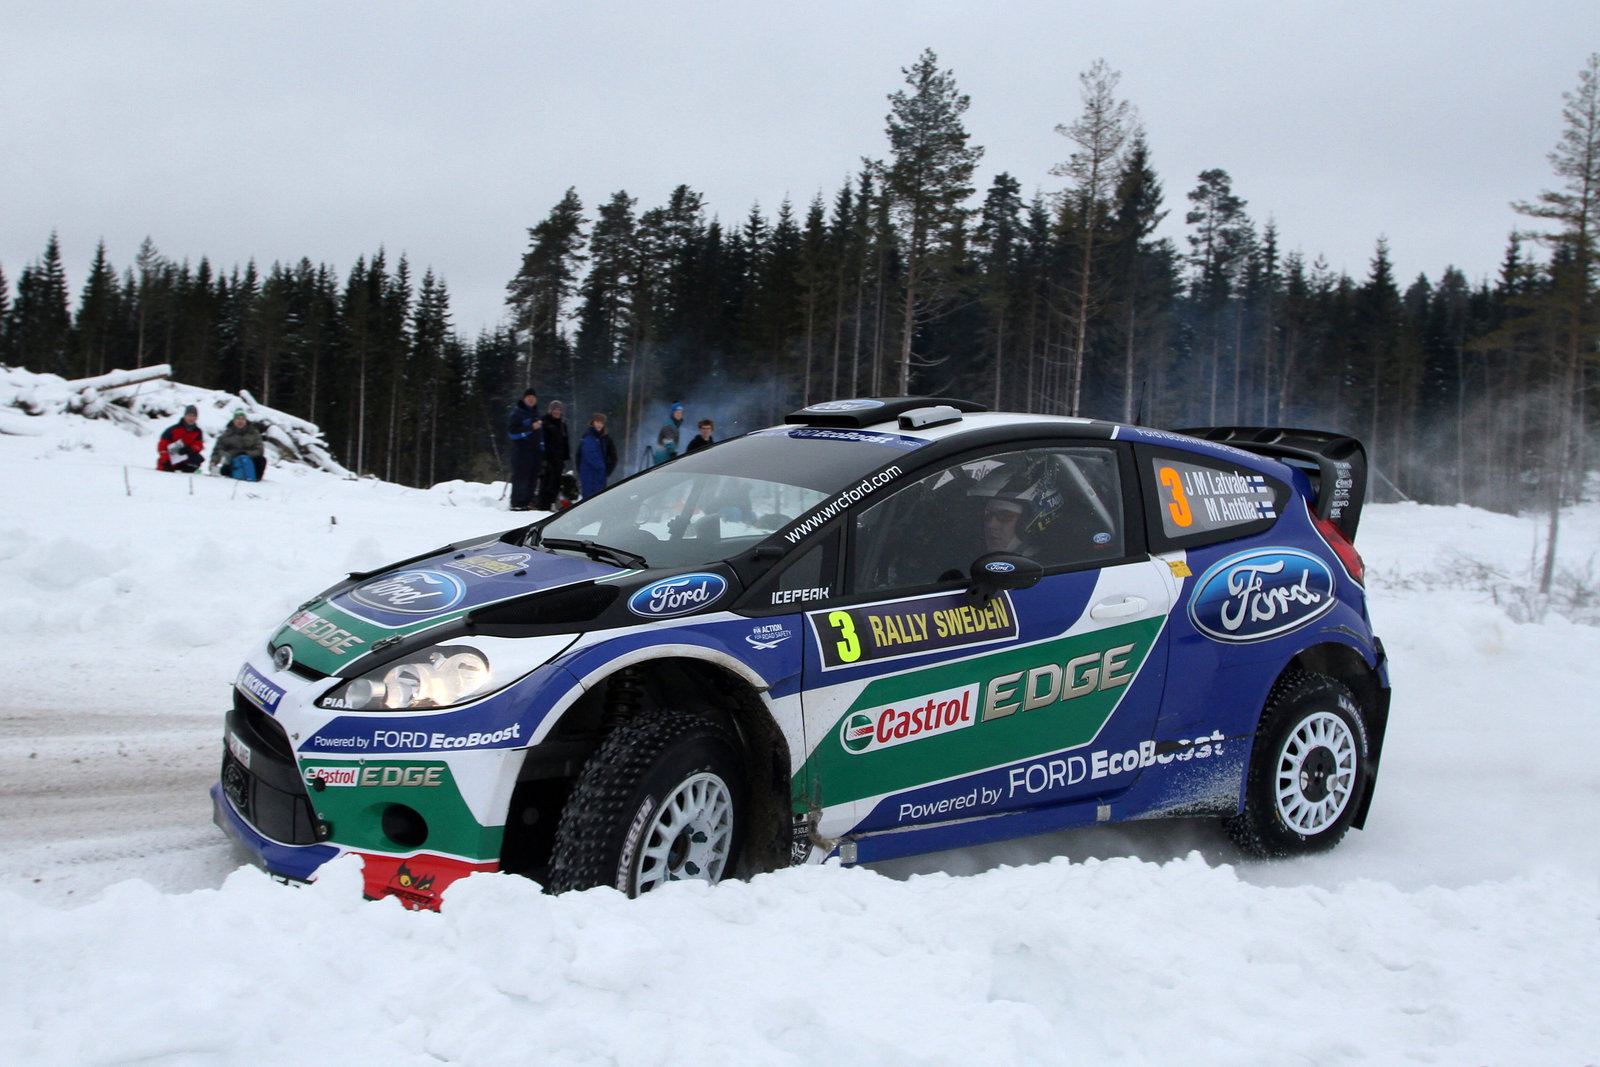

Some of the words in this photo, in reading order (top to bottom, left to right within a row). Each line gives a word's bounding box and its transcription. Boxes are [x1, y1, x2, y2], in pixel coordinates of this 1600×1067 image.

[784, 464, 903, 544] www.wrcford.com
[1159, 467, 1192, 528] 3
[1185, 473, 1194, 496] J
[1194, 472, 1209, 496] M
[1210, 470, 1249, 495] Latvala
[1203, 498, 1220, 522] M
[1222, 498, 1257, 521] Anttila
[988, 562, 1013, 572] Ford
[649, 580, 710, 612] Ford
[771, 587, 830, 605] ICEPEAK
[1220, 560, 1320, 631] Ford
[299, 618, 366, 655] EDGE
[762, 624, 783, 633] ACTION
[775, 630, 792, 638] SAFETY
[828, 610, 861, 663] 3
[868, 613, 929, 648] RALLY
[933, 596, 1010, 638] SWEDEN
[241, 671, 280, 706] MICHELIN
[875, 690, 970, 744] Castrol
[981, 642, 1137, 723] EDGE
[314, 736, 354, 747] Powered
[356, 736, 370, 749] by
[373, 730, 428, 748] FORD
[429, 722, 520, 749] EcoBoost
[360, 766, 446, 787] EDGE
[898, 792, 978, 822] Powered
[981, 785, 1003, 804] by
[1008, 755, 1088, 798] FORD
[617, 797, 654, 892] MICHELIN
